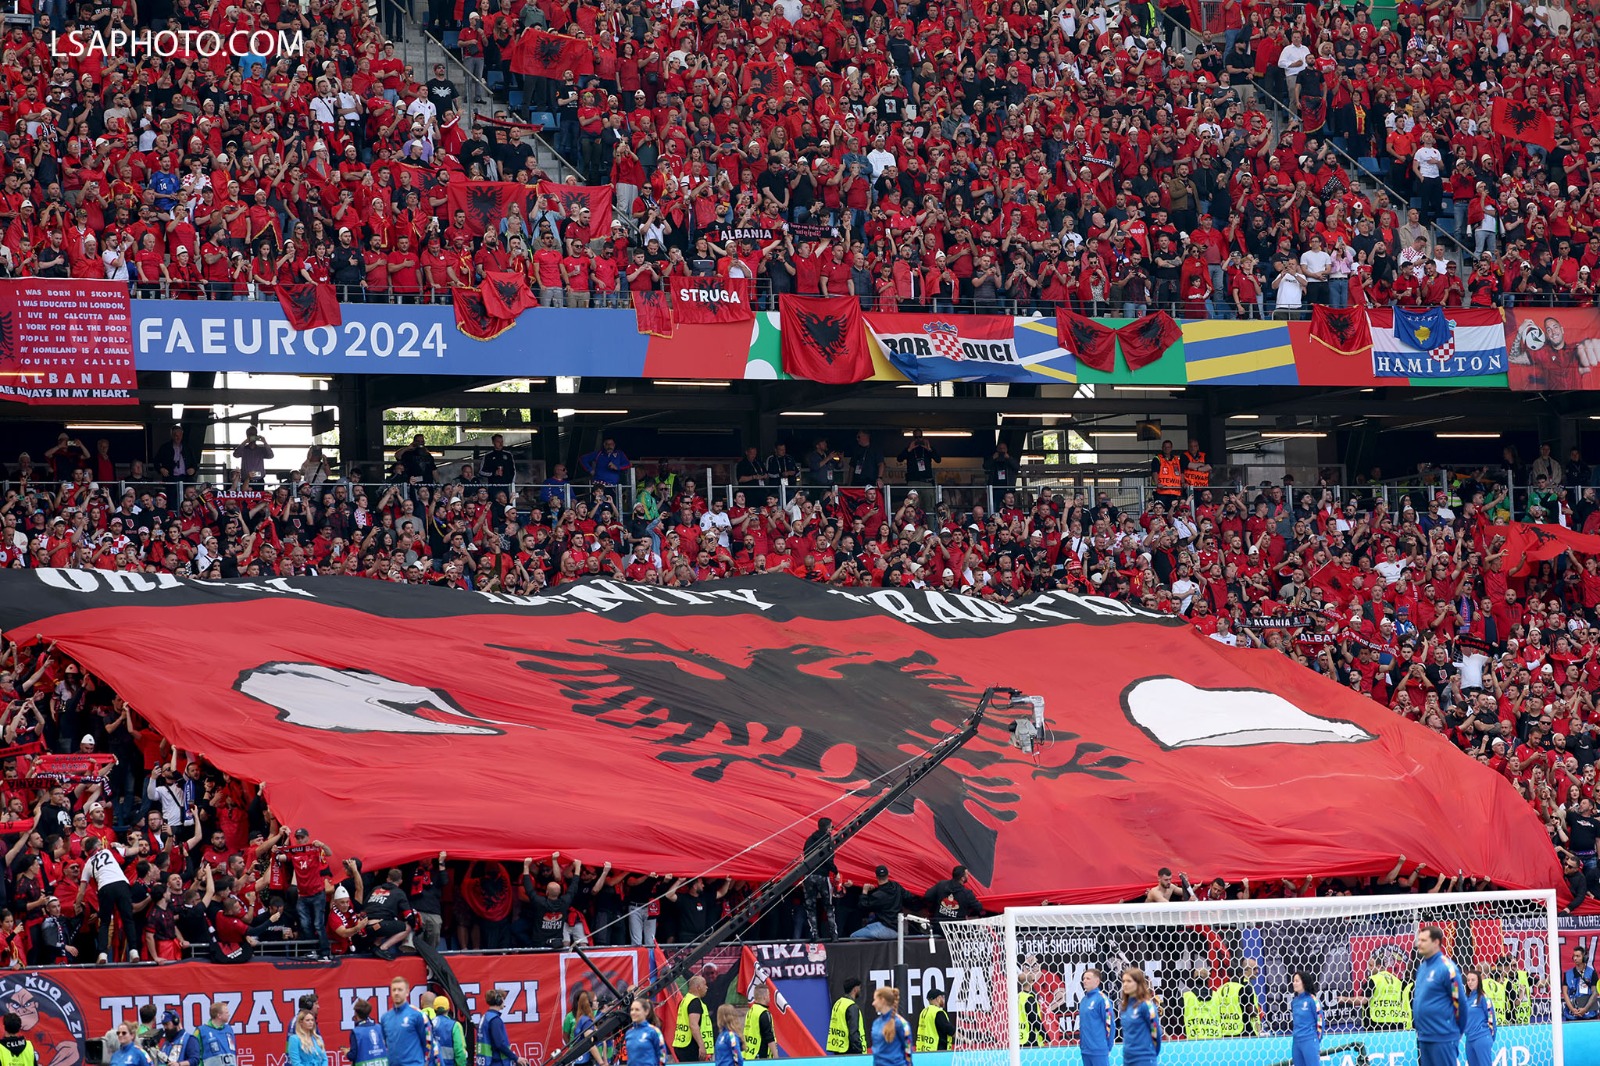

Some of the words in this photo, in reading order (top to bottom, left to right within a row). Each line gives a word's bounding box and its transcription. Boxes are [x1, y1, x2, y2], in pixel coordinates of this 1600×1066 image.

[720, 228, 772, 241] ALBANIA
[91, 291, 125, 299] SKOPJE,
[680, 288, 741, 304] STRUGA
[90, 302, 126, 310] LONDON,
[201, 318, 338, 355] EURO
[344, 321, 447, 358] 2024
[84, 358, 130, 366] CALLED
[1377, 354, 1501, 373] HAMILTON
[56, 389, 69, 398] IN
[72, 389, 89, 398] MY
[92, 389, 130, 398] HEART.
[216, 490, 262, 499] ALBANIA
[1253, 618, 1291, 627] ALBANIA
[1300, 633, 1337, 643] ALBAN
[92, 852, 113, 871] 22
[299, 859, 308, 869] 14
[757, 943, 804, 960] TKZ
[784, 963, 825, 977] TOUR
[25, 976, 62, 1001] KUQ
[63, 1001, 75, 1016] E
[71, 1020, 82, 1039] ZI
